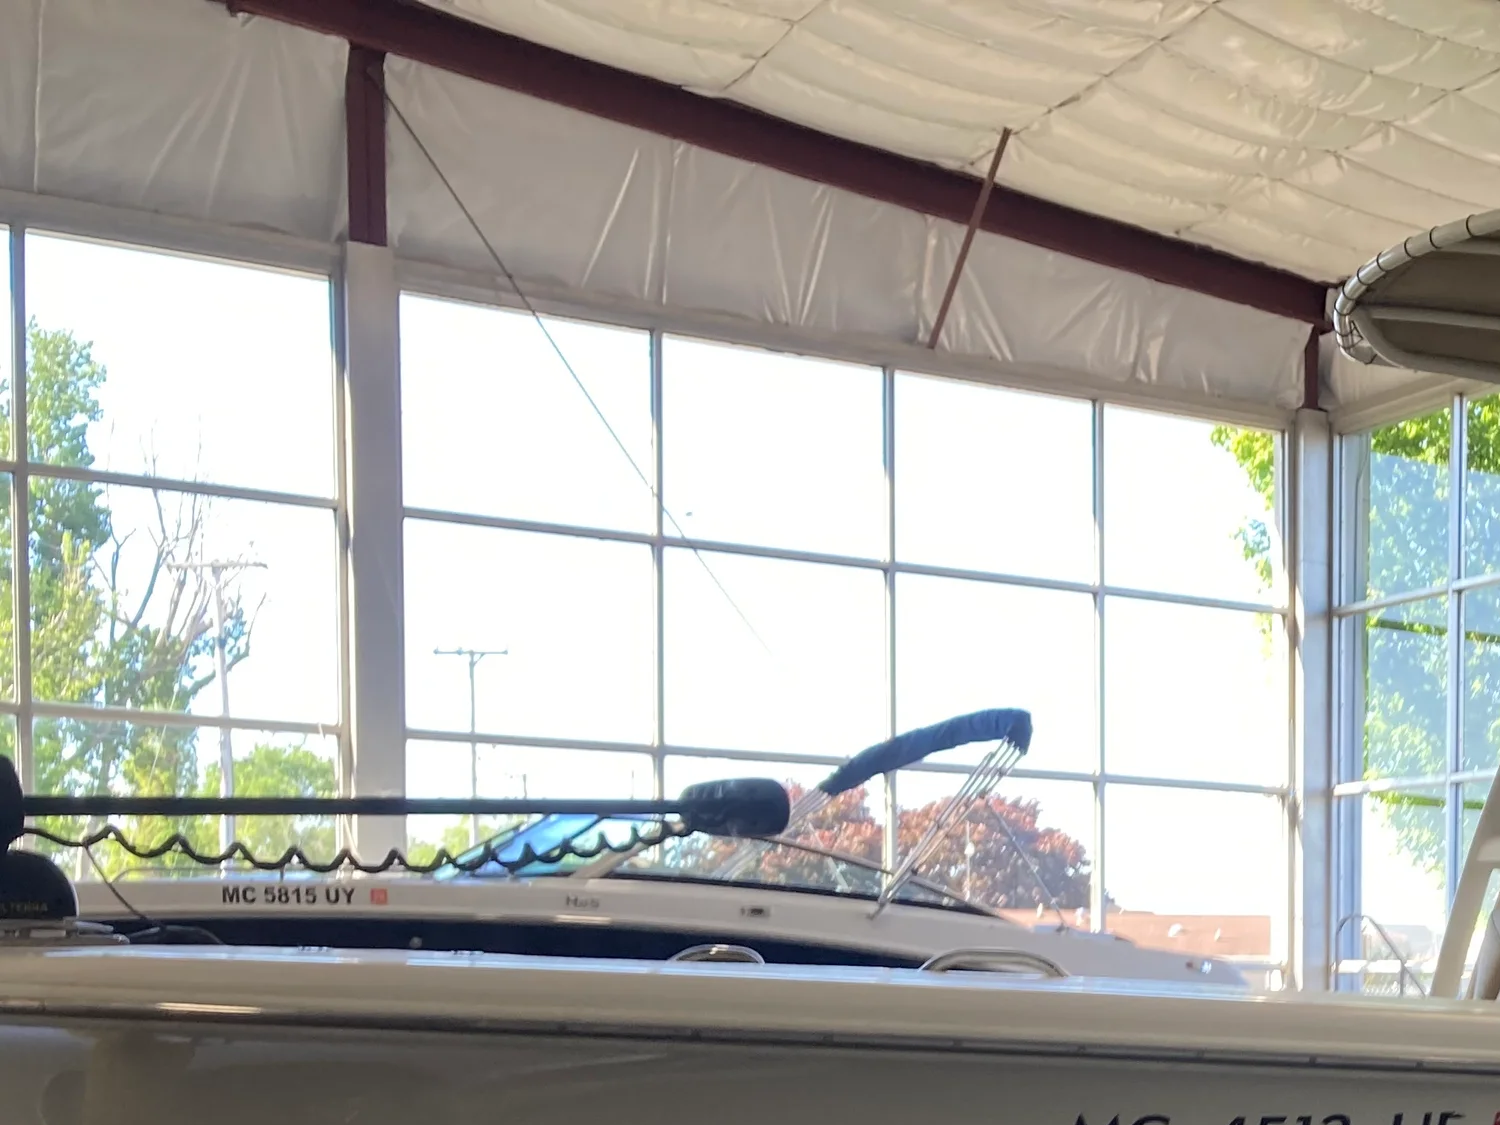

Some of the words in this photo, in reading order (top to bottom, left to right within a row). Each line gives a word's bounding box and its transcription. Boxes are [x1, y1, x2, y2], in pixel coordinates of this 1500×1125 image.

[222, 886, 256, 903] MC
[264, 887, 317, 904] 5815
[326, 888, 355, 904] UY
